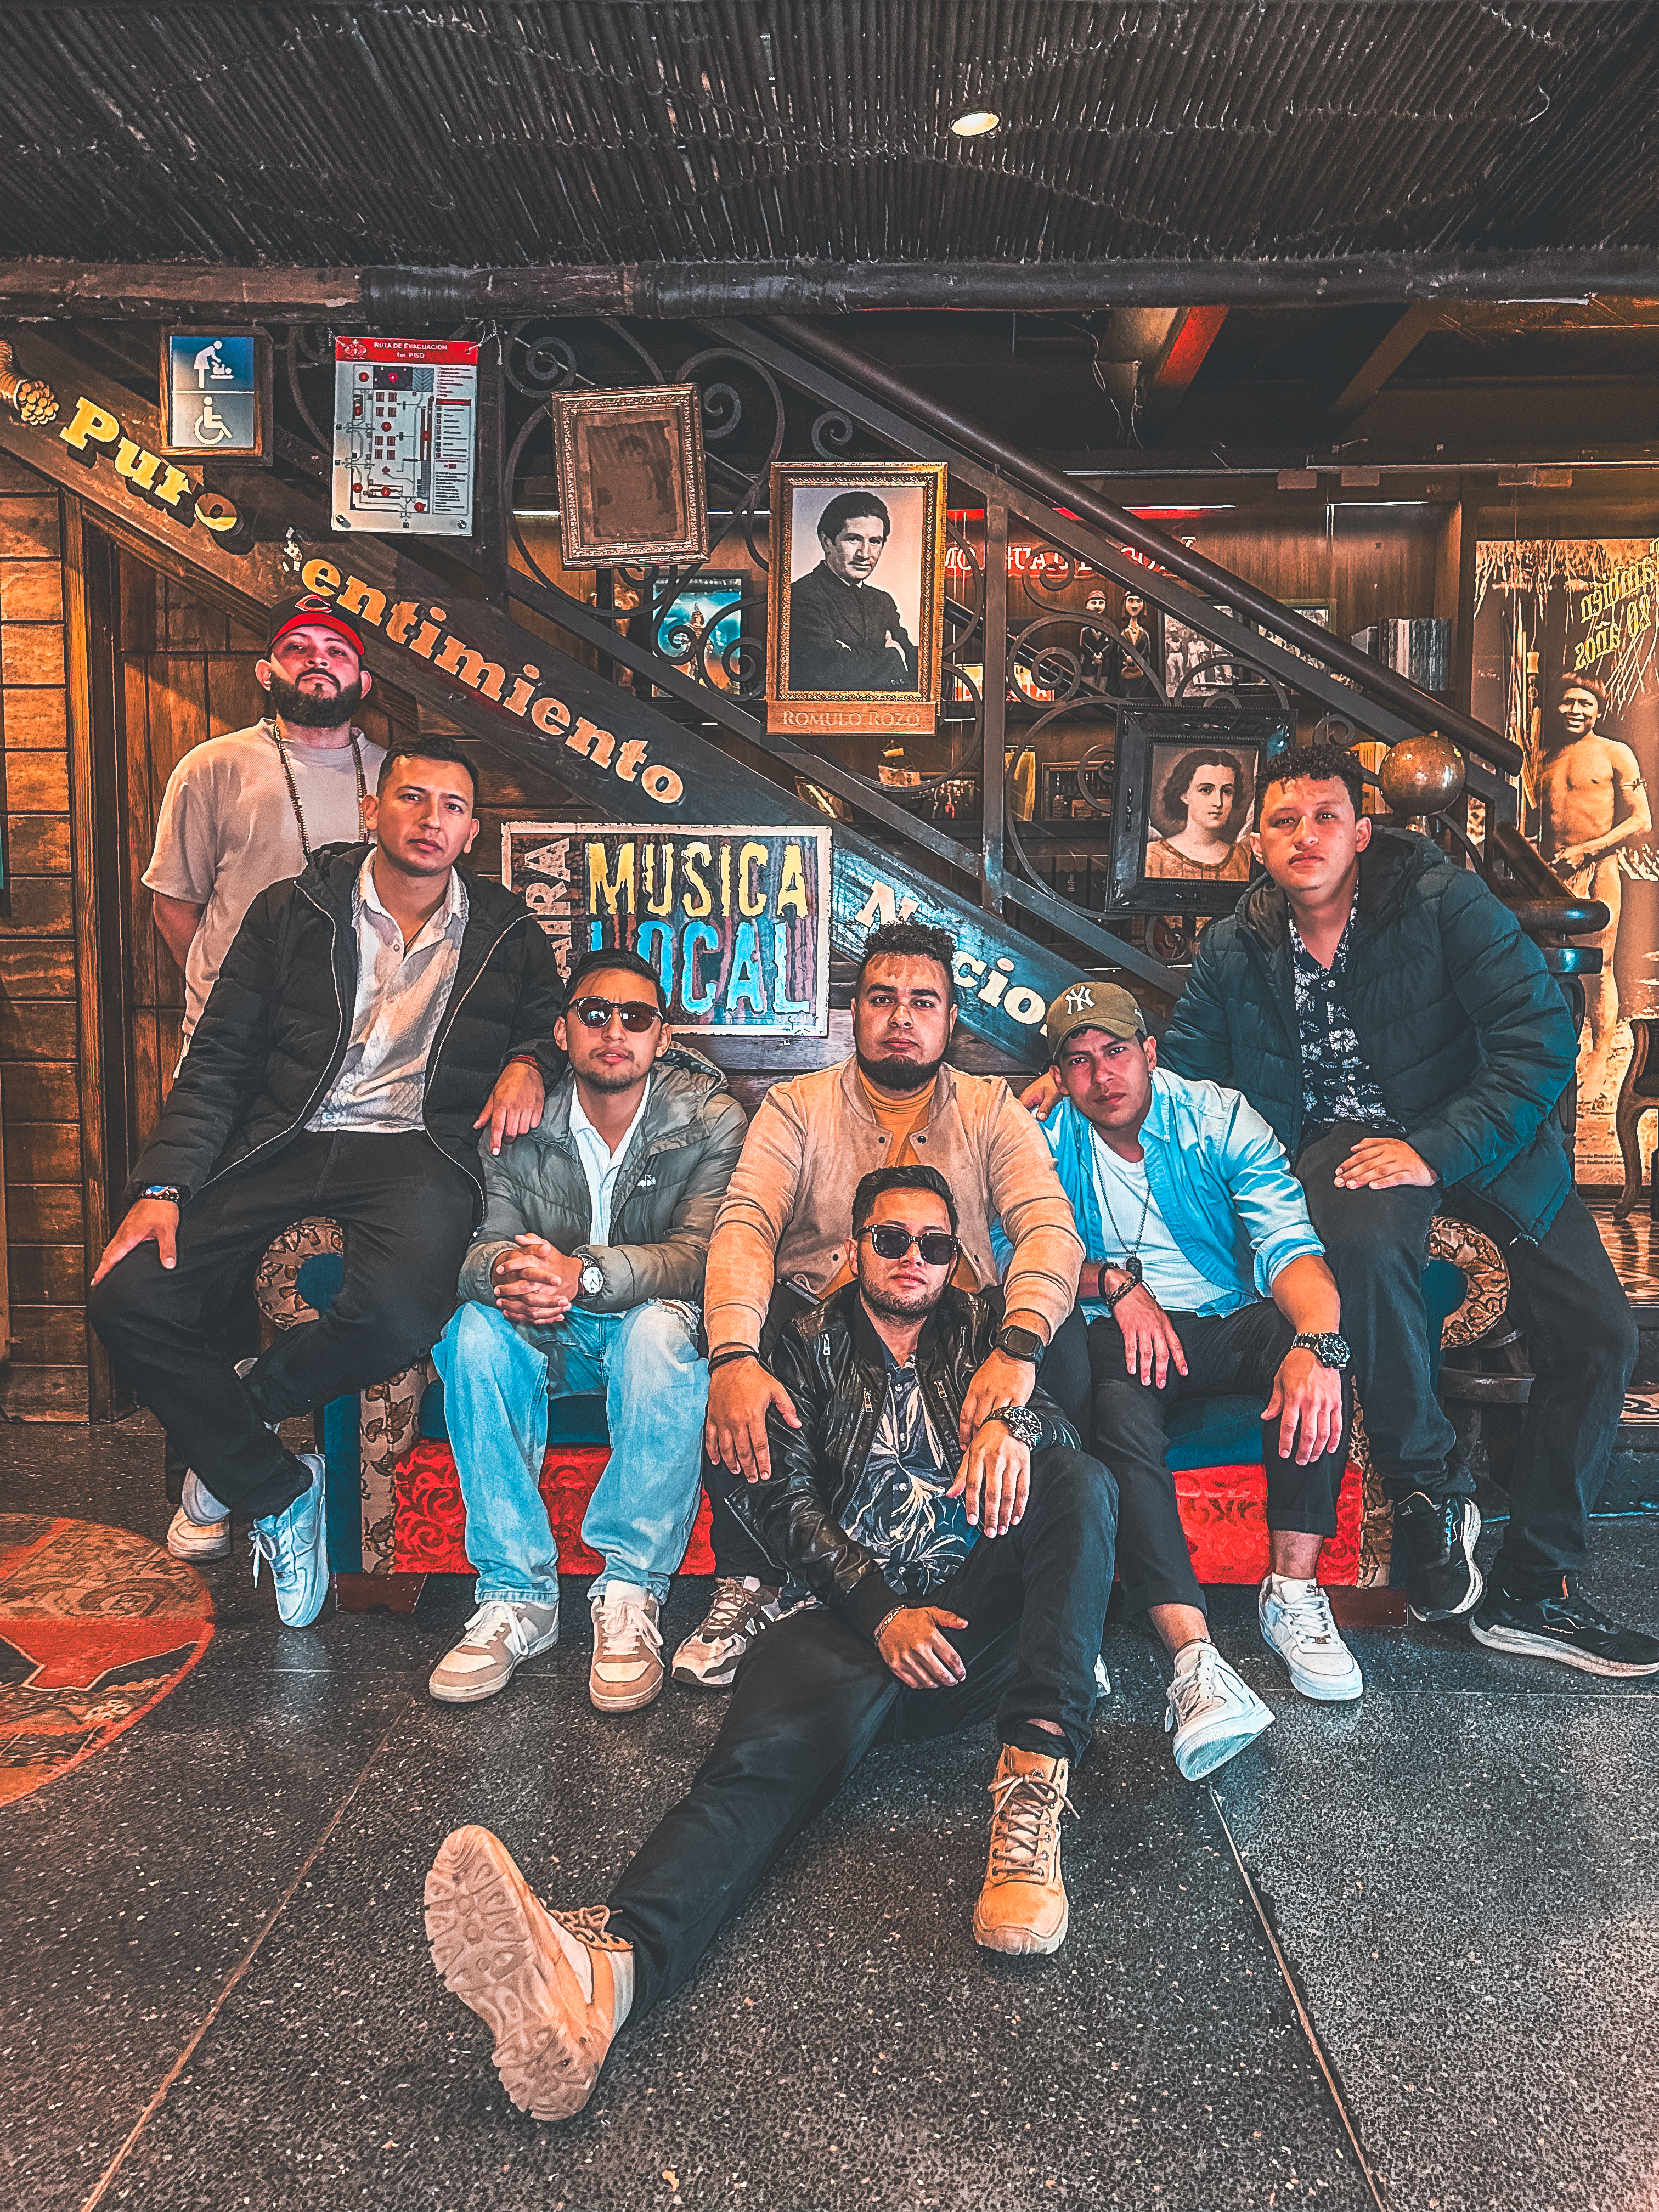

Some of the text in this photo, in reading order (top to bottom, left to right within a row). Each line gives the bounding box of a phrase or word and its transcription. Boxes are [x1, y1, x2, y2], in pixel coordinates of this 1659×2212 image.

[59, 396, 238, 531] Puro
[282, 531, 684, 804] entimiento
[782, 710, 920, 726] ROMULO ROZO
[585, 842, 808, 918] MUSICA
[1065, 985, 1095, 1015] NY
